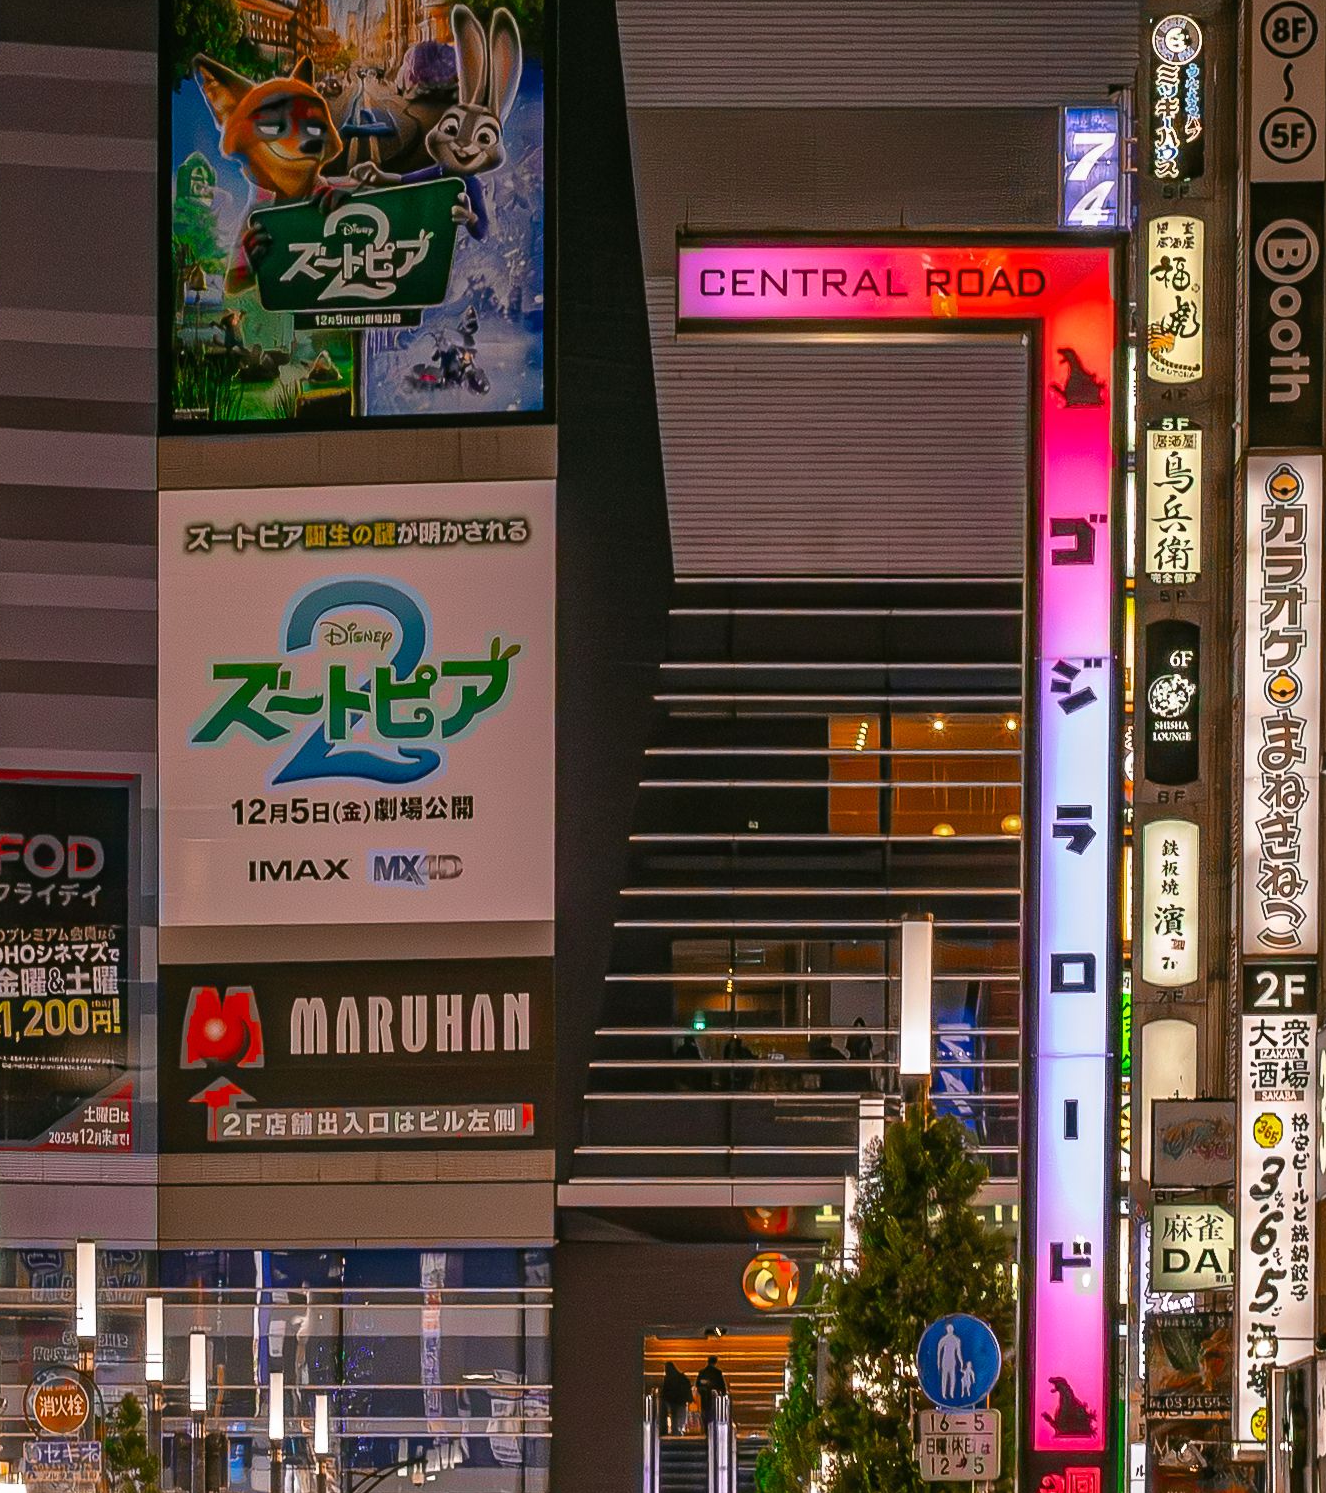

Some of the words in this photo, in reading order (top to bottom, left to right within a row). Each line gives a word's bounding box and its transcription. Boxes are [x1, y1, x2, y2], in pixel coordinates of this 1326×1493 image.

[280, 229, 434, 287] ズートピア
[699, 267, 908, 299] CENTRAL
[931, 267, 1047, 299] ROAD
[1256, 218, 1320, 404] Booth
[1162, 419, 1188, 430] 5F
[1261, 503, 1308, 673] カラオケ
[1169, 650, 1194, 667] 6F
[191, 636, 521, 745] ズートピア
[1153, 731, 1192, 742] LOUNGE
[1155, 721, 1189, 731] SHISHA
[230, 793, 475, 827] 12月5日(金)劇場公開
[1256, 708, 1307, 951] まねきねこ
[249, 857, 352, 883] IMAX
[1161, 839, 1180, 897] 鉄板焼
[1049, 513, 1108, 1284] ゴジラロード
[1255, 974, 1306, 1007] 2F
[290, 992, 531, 1056] MARUHAN
[1249, 1018, 1311, 1049] 大衆
[1259, 1049, 1301, 1059] IZAKAYA
[1250, 1061, 1311, 1089] 酒場
[1261, 1091, 1299, 1101] SAKABA
[83, 1106, 130, 1124] 土曜日は
[222, 1105, 517, 1138] 2F店舗出入口はビル左側
[1256, 1121, 1280, 1146] 365
[1292, 1112, 1312, 1303] 格安ビールと鉄鍋餃子
[1163, 1214, 1224, 1242] 麻雀
[39, 1394, 85, 1417] 消火栓
